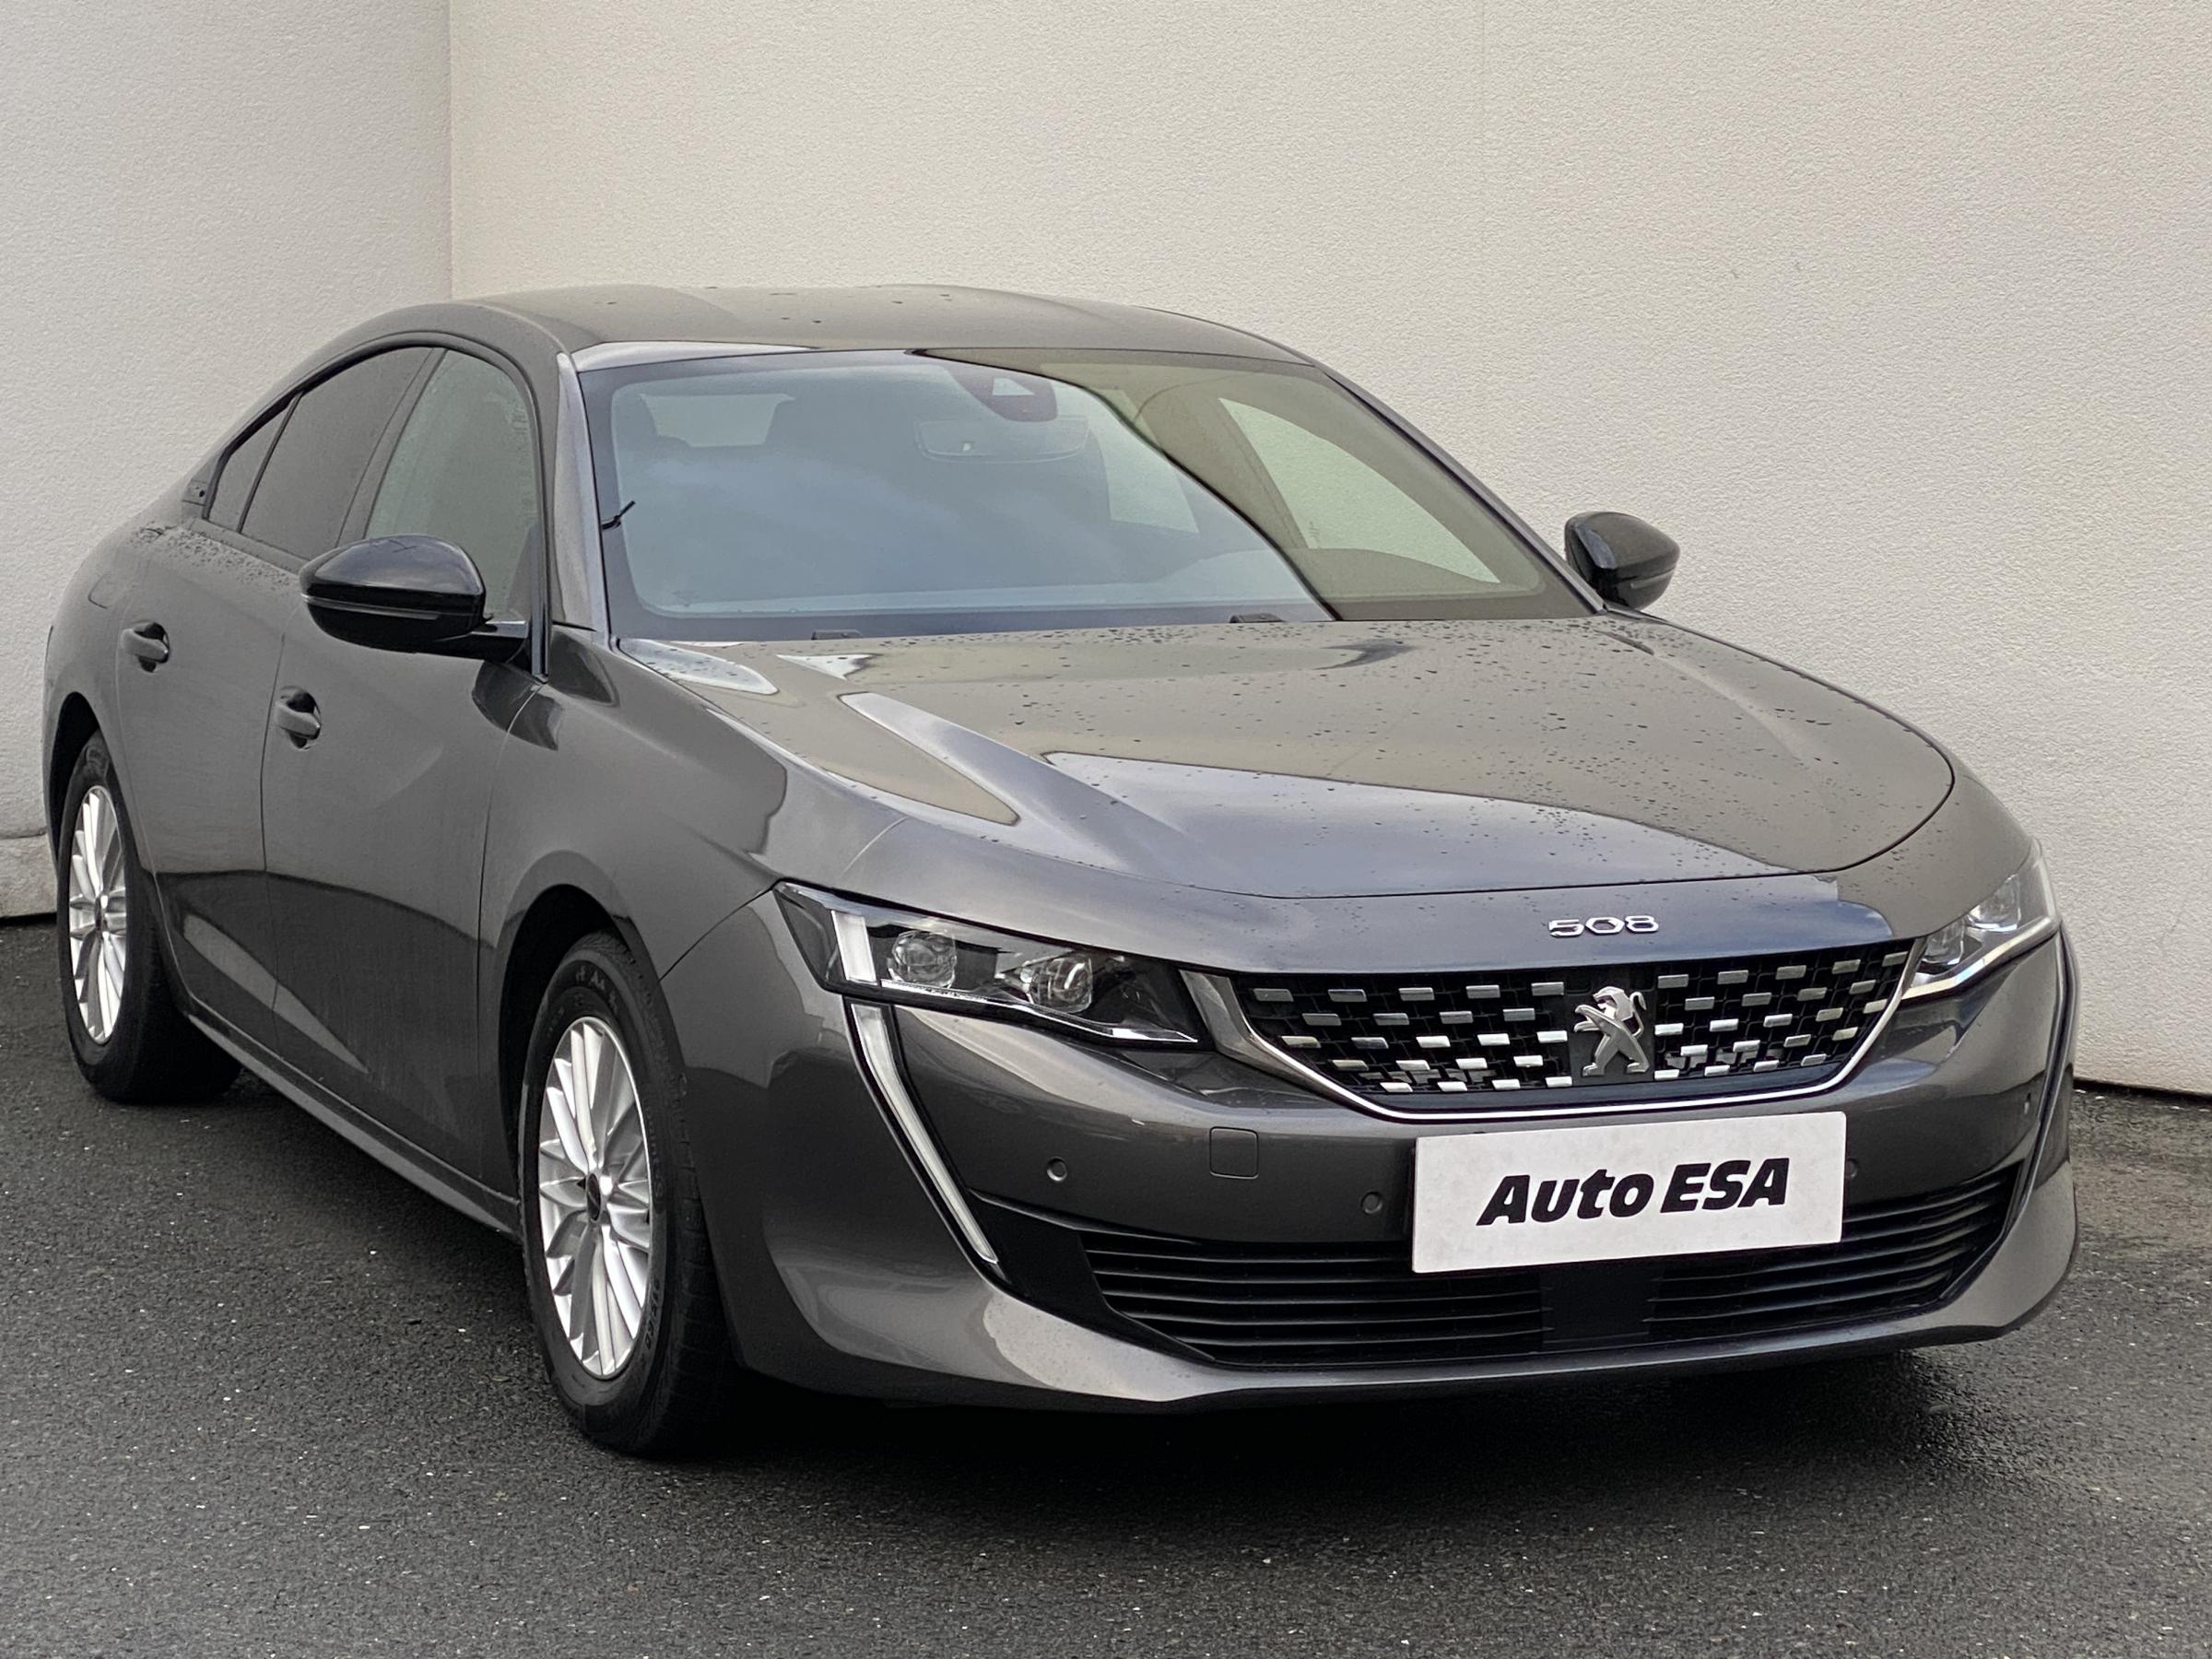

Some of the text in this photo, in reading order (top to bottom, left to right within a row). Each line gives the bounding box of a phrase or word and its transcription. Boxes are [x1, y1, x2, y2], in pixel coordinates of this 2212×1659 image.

[1548, 915, 1659, 937] 508
[1476, 1157, 1790, 1226] Auto ESA
